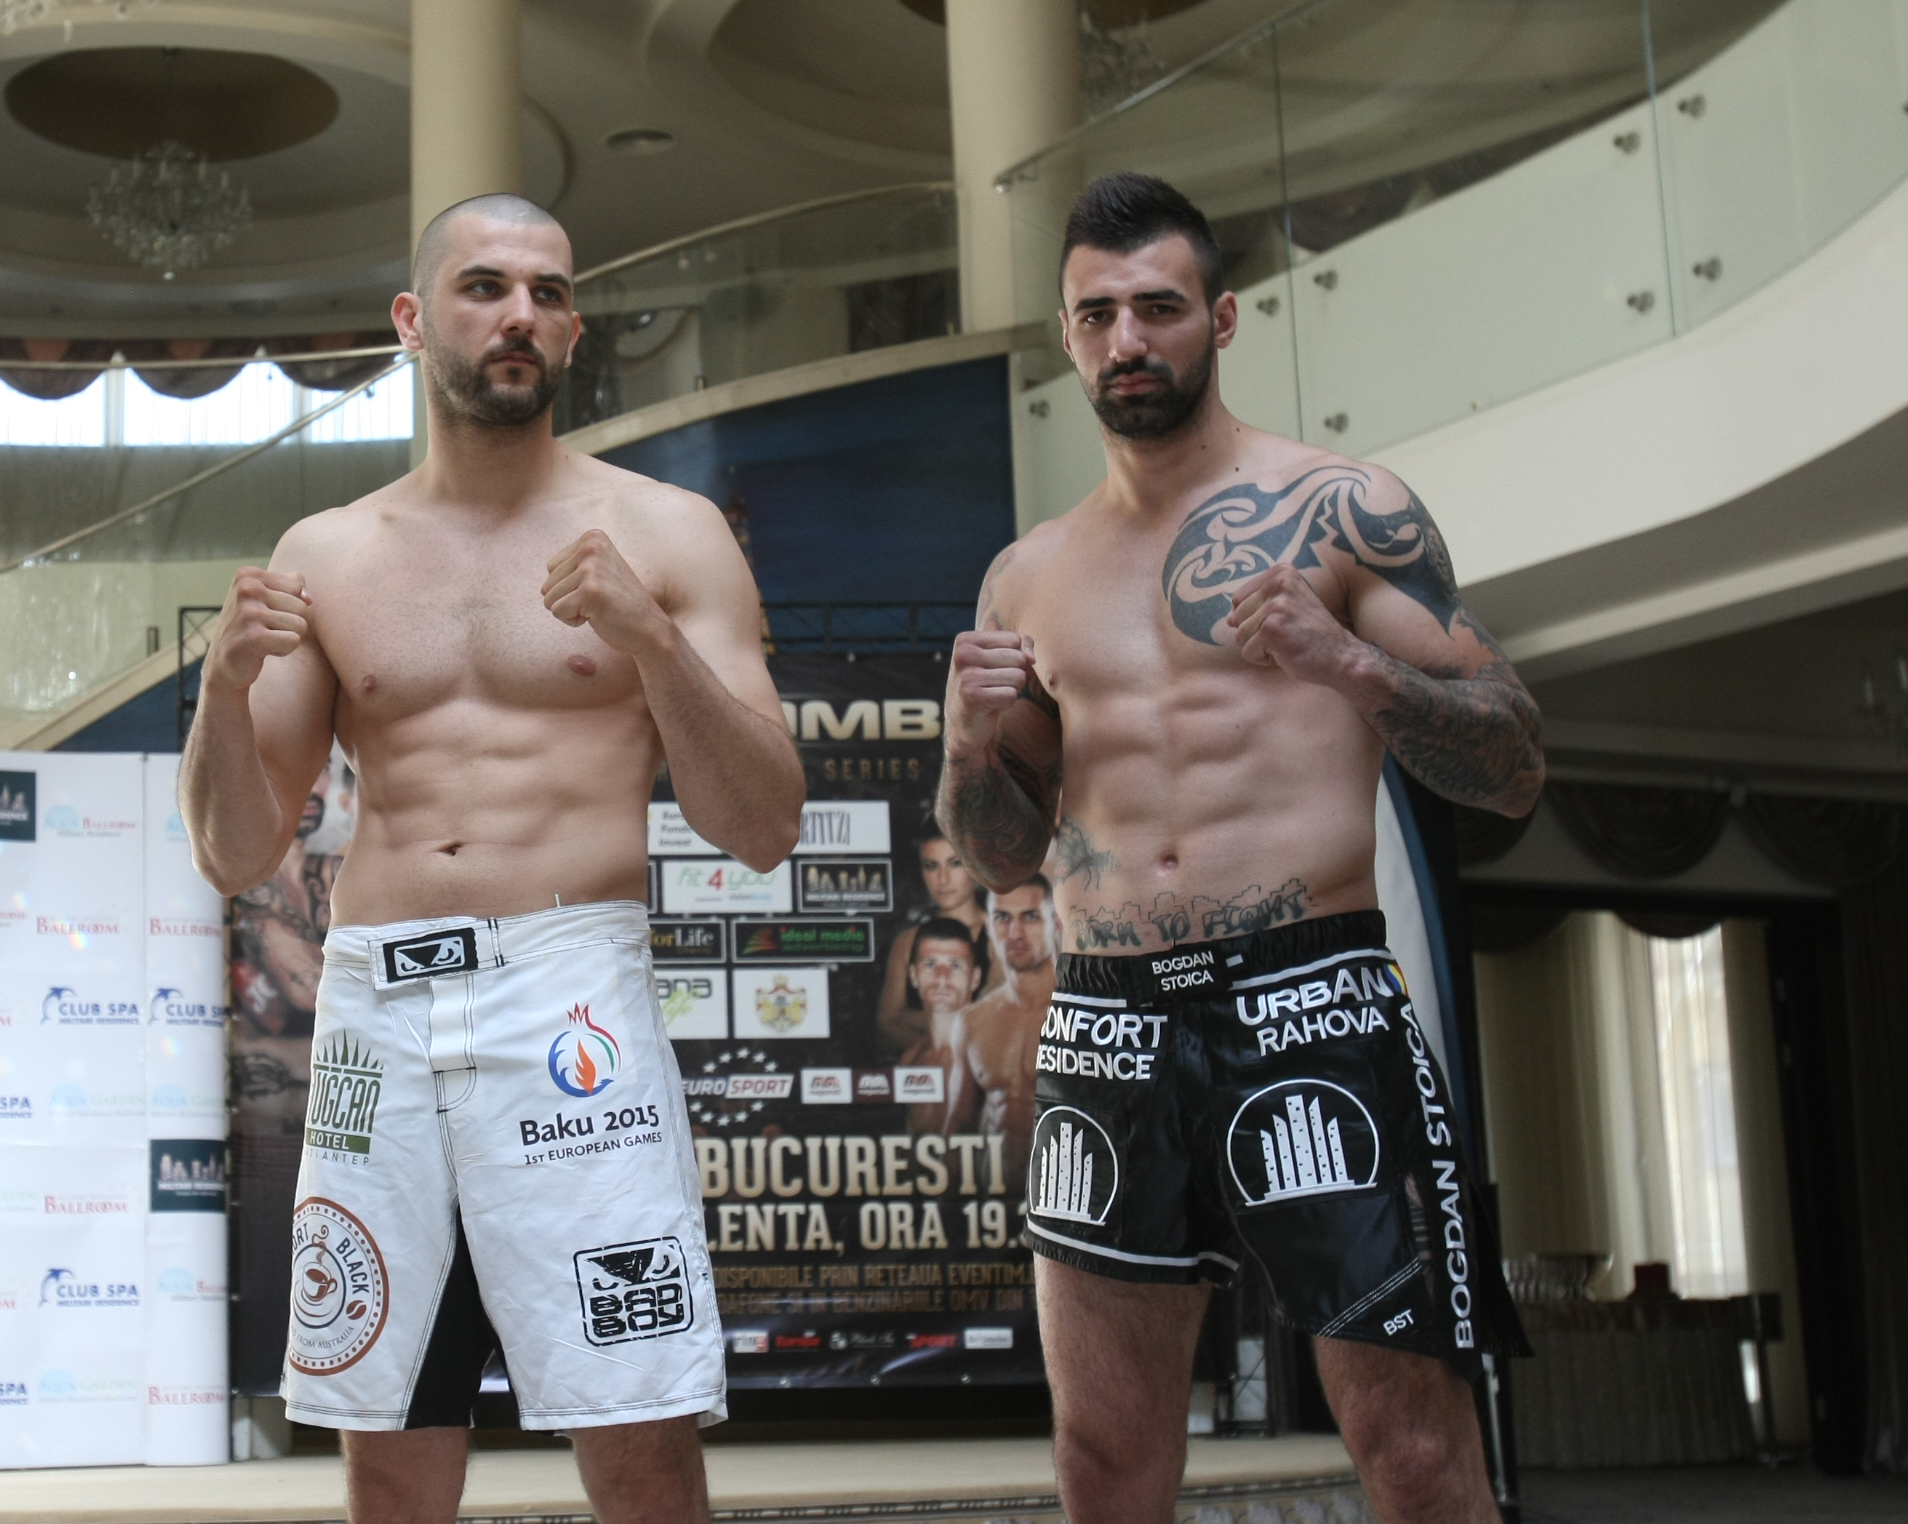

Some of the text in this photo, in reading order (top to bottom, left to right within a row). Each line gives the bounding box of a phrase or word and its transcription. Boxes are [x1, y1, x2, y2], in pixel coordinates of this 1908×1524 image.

[825, 758, 920, 781] SERIES
[708, 868, 724, 890] 4
[36, 917, 119, 935] BALLROOM
[780, 926, 865, 942] ideal media
[1152, 951, 1215, 975] BOGDAN
[1161, 969, 1214, 992] STOICA
[1236, 967, 1395, 1026] URBAN
[59, 1003, 139, 1016] CLUB SPA
[166, 1004, 205, 1017] CLUB
[1256, 1006, 1390, 1057] RAHOVA
[519, 1105, 659, 1147] Baku 2015
[309, 1130, 350, 1150] HOTEL
[548, 1138, 621, 1161] EUROPEAN
[623, 1131, 662, 1148] GAMES
[694, 1136, 1006, 1198] BUCURESTI
[1400, 1002, 1474, 1349] BOGDAN STOICA
[44, 1196, 129, 1214] BALLROOM
[859, 1201, 949, 1250] ORA
[335, 1237, 370, 1294] BLACK
[819, 1266, 859, 1287] PRIN
[57, 1285, 139, 1298] CLUB SPA
[589, 1283, 683, 1317] BAD
[591, 1303, 685, 1338] BOY
[1383, 1309, 1415, 1336] BST
[296, 1334, 316, 1348] FROM
[317, 1326, 355, 1349] AUSTRALIA
